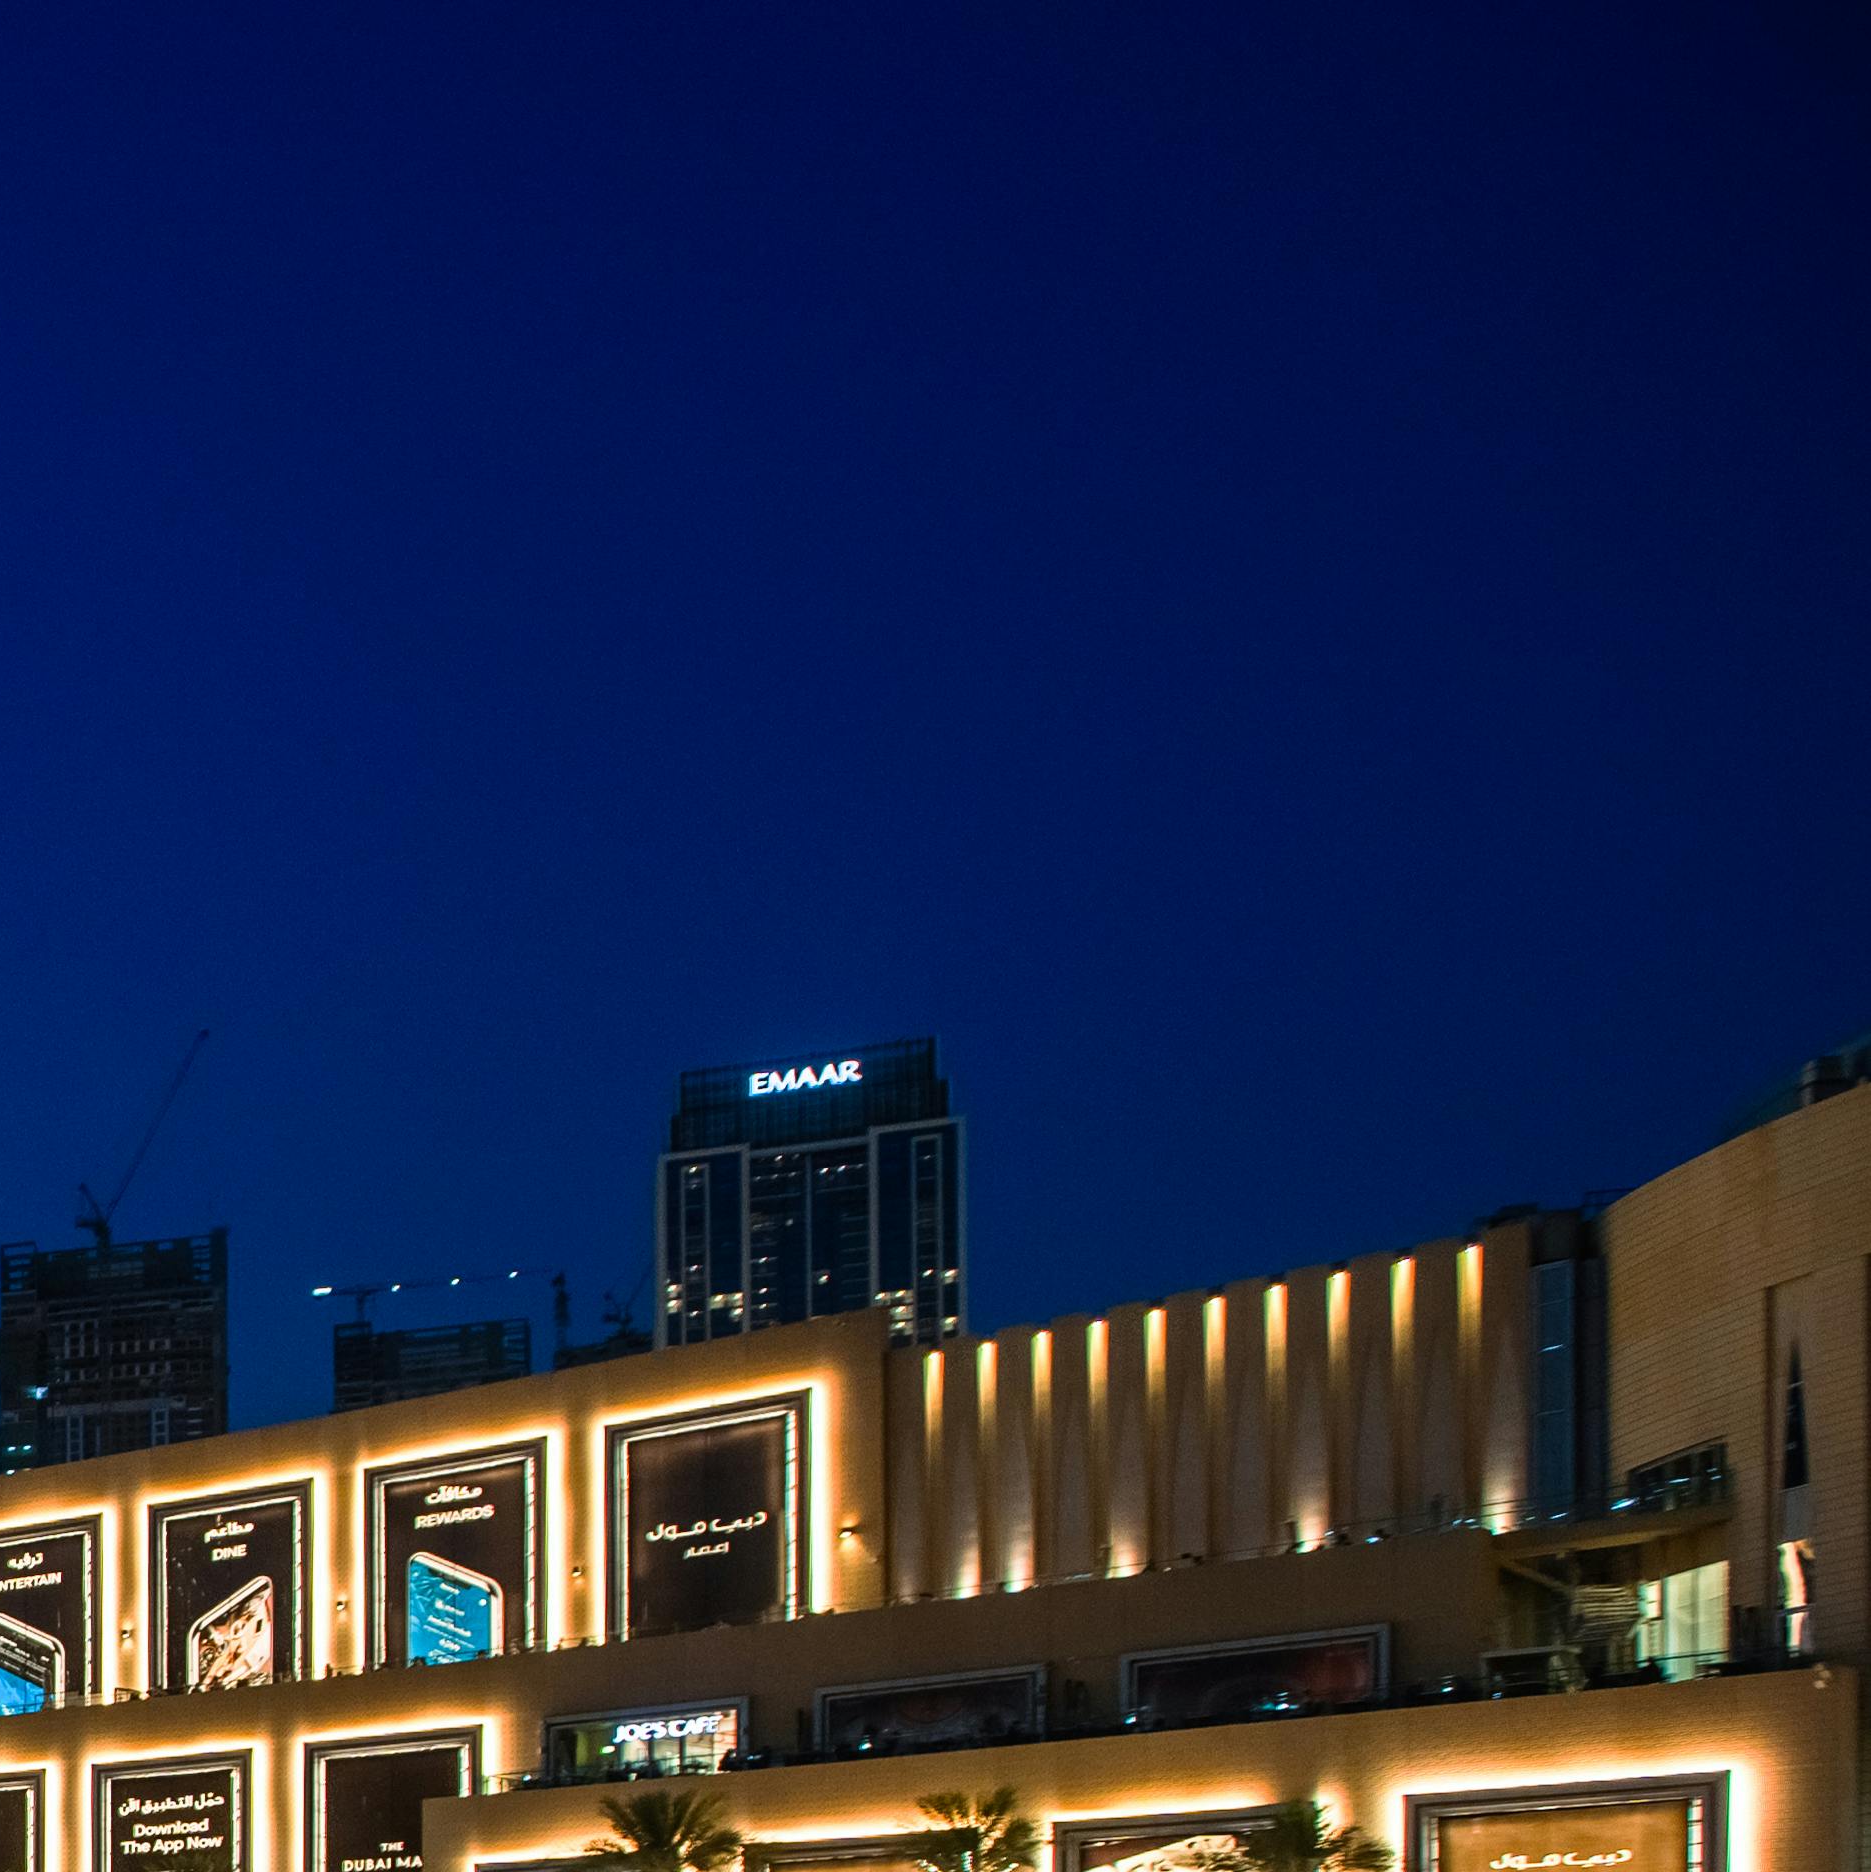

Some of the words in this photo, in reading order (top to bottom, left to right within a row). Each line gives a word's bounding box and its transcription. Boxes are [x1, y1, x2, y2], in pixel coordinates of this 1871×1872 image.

[748, 1060, 863, 1097] EMAAR
[414, 1504, 496, 1530] REWARDS
[211, 1544, 248, 1562] DINE
[132, 1818, 210, 1838] Download
[120, 1839, 151, 1855] The
[152, 1838, 184, 1856] App
[186, 1835, 225, 1851] Now
[379, 1842, 405, 1853] THE
[341, 1858, 392, 1872] DUBAI
[395, 1855, 423, 1870] MA
